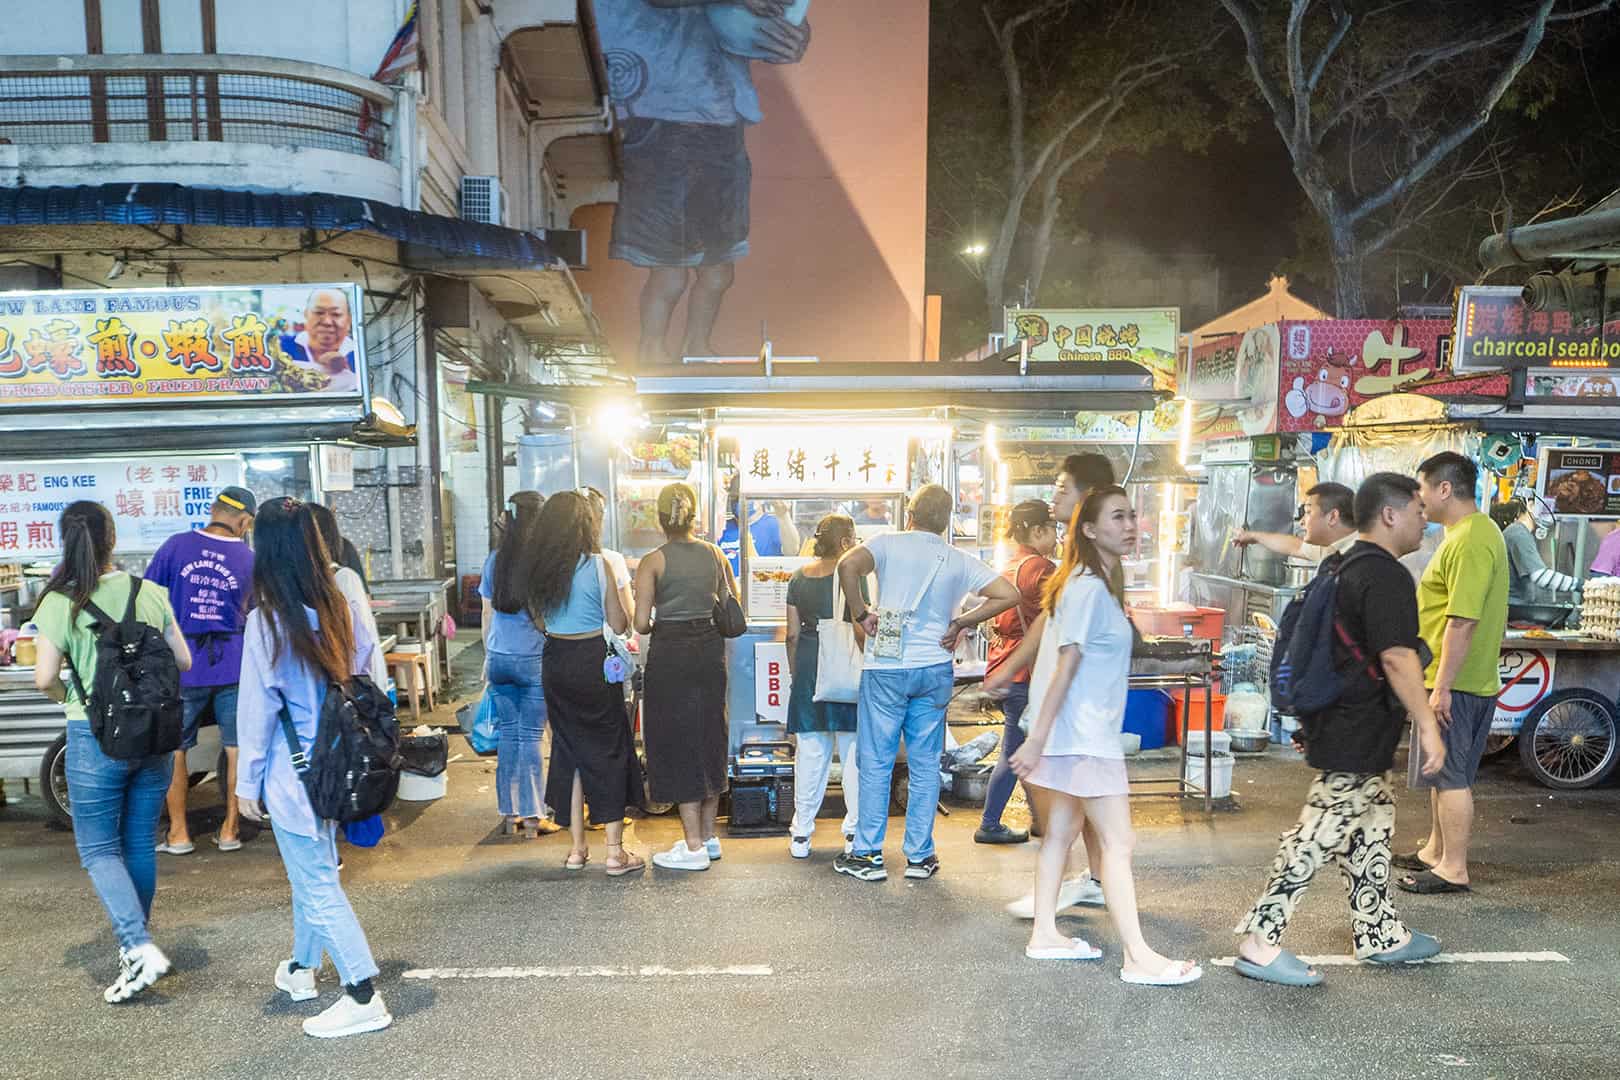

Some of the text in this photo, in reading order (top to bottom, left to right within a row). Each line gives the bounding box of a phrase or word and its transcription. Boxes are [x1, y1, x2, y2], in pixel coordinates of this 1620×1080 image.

[34, 299, 97, 314] LANE
[106, 295, 201, 313] FAMOUS
[1473, 336, 1554, 357] charcoal
[1058, 349, 1131, 361] Chinese BBQ
[1, 377, 271, 397] FRIED OYSTER FRIED PRAWN
[43, 475, 96, 488] ENG KEE
[32, 502, 65, 512] FAMOUS
[185, 502, 213, 516] OYS
[768, 662, 780, 706] BBQ
